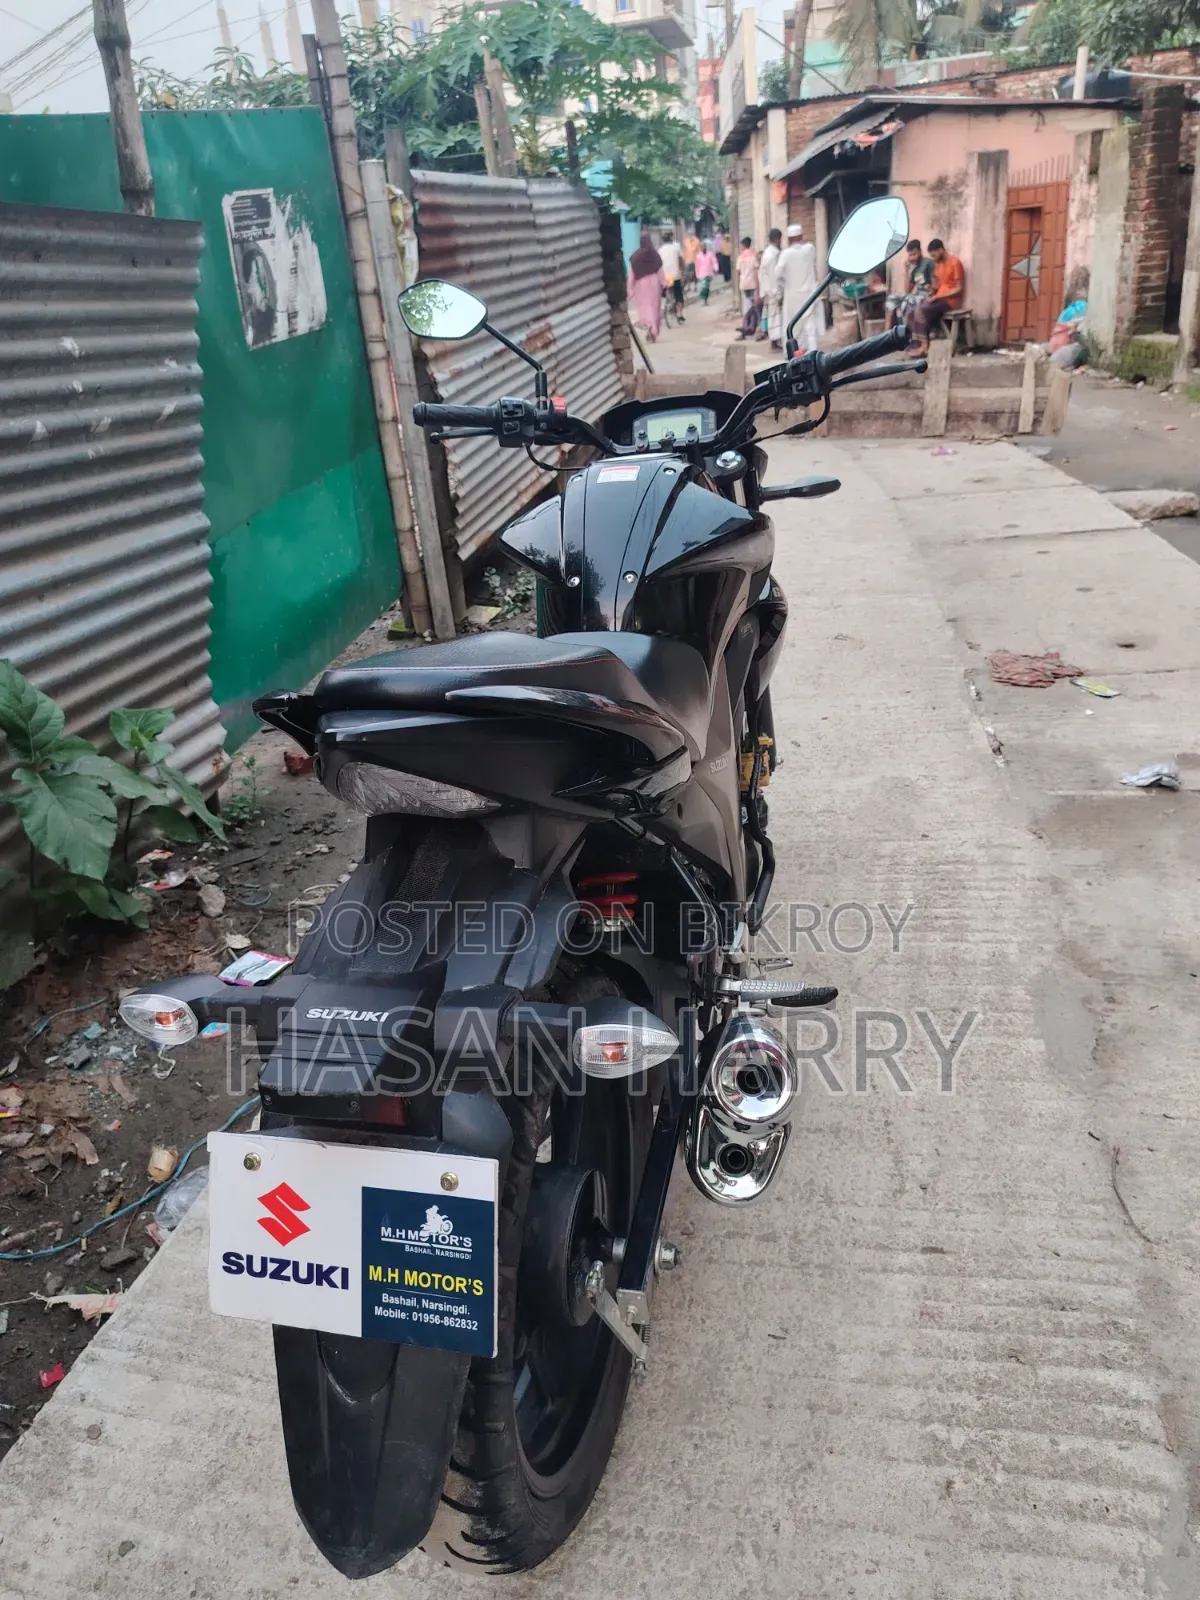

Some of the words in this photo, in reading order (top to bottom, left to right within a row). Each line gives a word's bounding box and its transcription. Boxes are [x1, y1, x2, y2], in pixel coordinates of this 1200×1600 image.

[305, 1007, 390, 1023] SUZUKI
[435, 1248, 472, 1260] NARSINGDI
[221, 1251, 350, 1291] SUZUKI
[368, 1264, 399, 1284] M.H
[404, 1269, 484, 1296] MOTOR'S
[381, 1292, 420, 1309] Bashail,
[421, 1298, 471, 1316] Narsingdi.
[374, 1305, 410, 1321] Mobile:
[411, 1311, 479, 1331] 01956-862832
